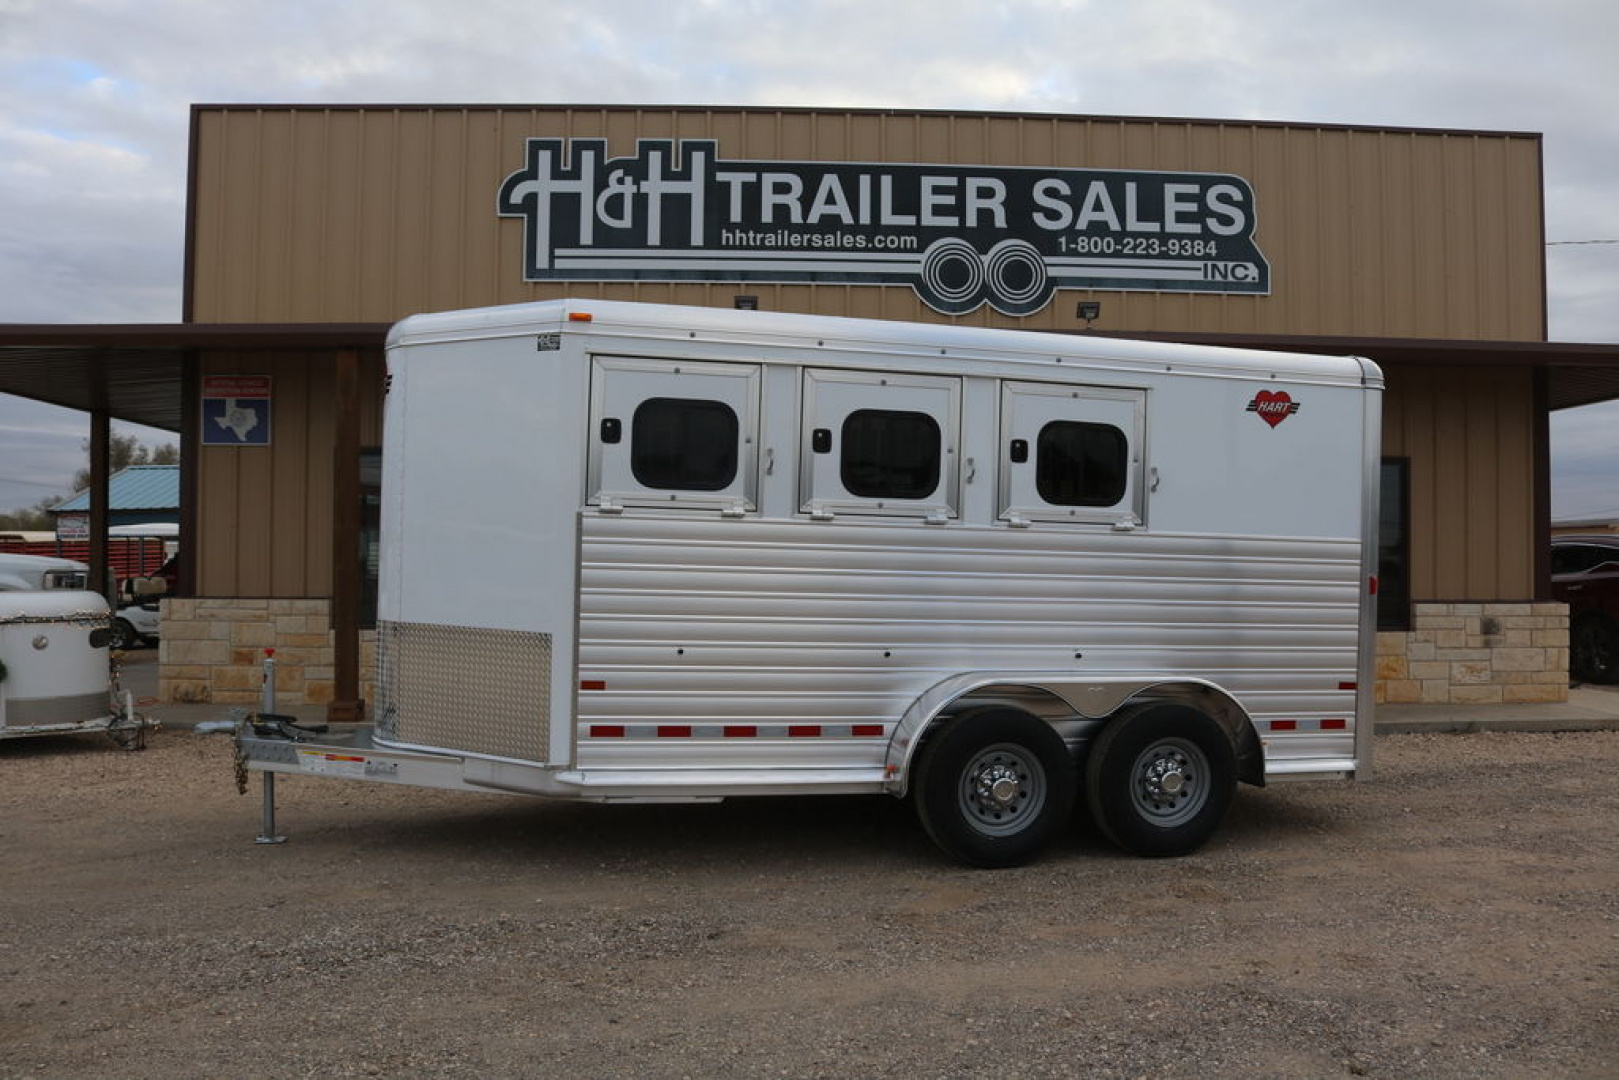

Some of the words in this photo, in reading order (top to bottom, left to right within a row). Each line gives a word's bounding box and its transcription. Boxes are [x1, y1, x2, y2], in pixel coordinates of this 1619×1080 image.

[509, 150, 705, 269] H&H
[716, 172, 1007, 229] TRAILER
[1032, 178, 1245, 236] SALES
[722, 229, 918, 248] hhtrailersales.com
[1058, 236, 1218, 257] 1-800-223-9384
[1202, 262, 1258, 281] INC.
[1257, 401, 1290, 412] HART
